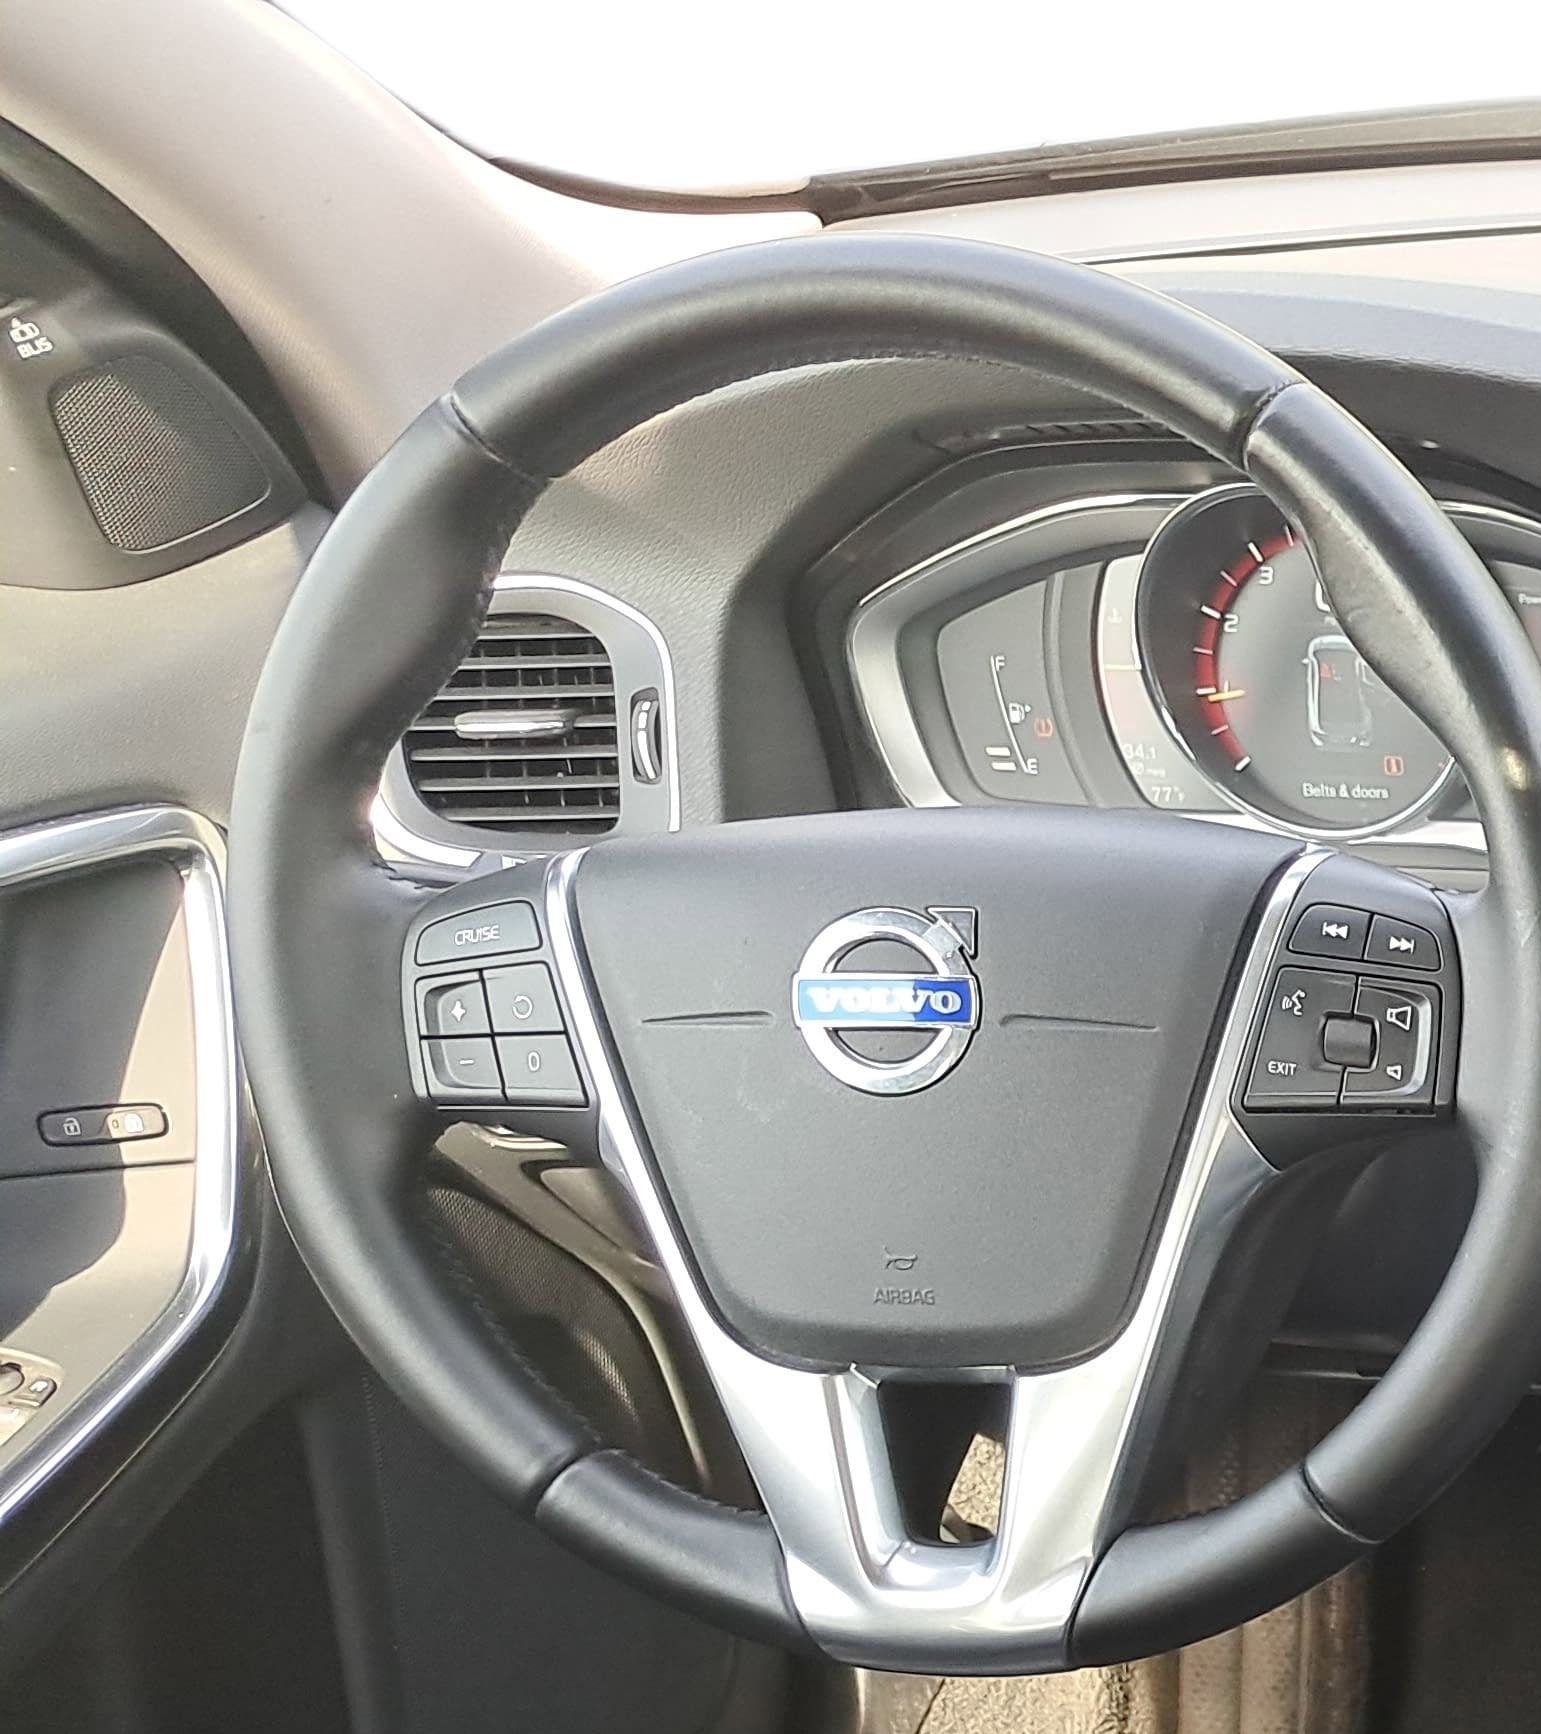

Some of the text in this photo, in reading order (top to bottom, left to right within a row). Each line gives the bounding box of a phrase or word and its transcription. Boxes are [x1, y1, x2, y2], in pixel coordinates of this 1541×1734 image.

[1258, 567, 1275, 585] 3
[1223, 614, 1239, 633] 2
[994, 656, 1006, 671] F
[1027, 758, 1039, 775] E
[1303, 783, 1389, 799] Belts & doors
[454, 924, 501, 947] CRUISE
[807, 985, 962, 1015] VOLVO
[1267, 1060, 1297, 1076] EXIT
[873, 1287, 936, 1306] AIRBAG
